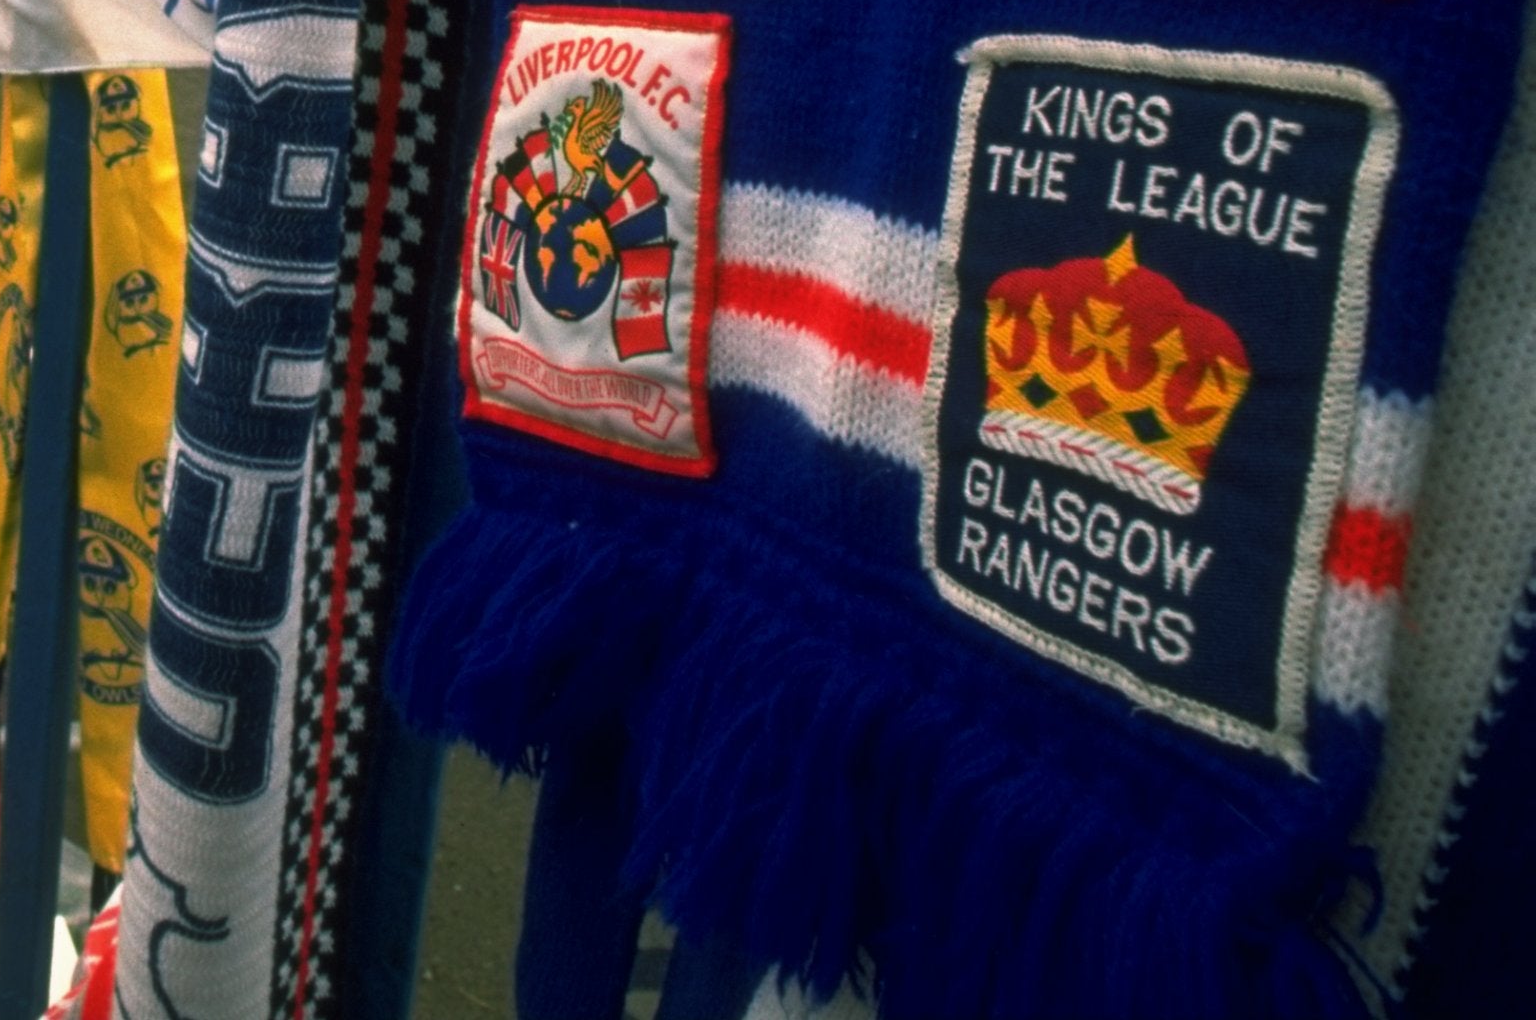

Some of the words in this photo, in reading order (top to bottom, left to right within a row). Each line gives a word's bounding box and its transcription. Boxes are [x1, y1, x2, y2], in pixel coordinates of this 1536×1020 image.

[506, 36, 645, 107] LIVERPOOL
[640, 64, 691, 130] F.C.
[1021, 83, 1175, 149] KINGS
[1222, 110, 1304, 173] OF
[985, 144, 1077, 204] THE
[1107, 159, 1329, 260] LEAGUE
[964, 458, 1215, 597] GLASGOW
[956, 517, 1197, 665] RANGERS
